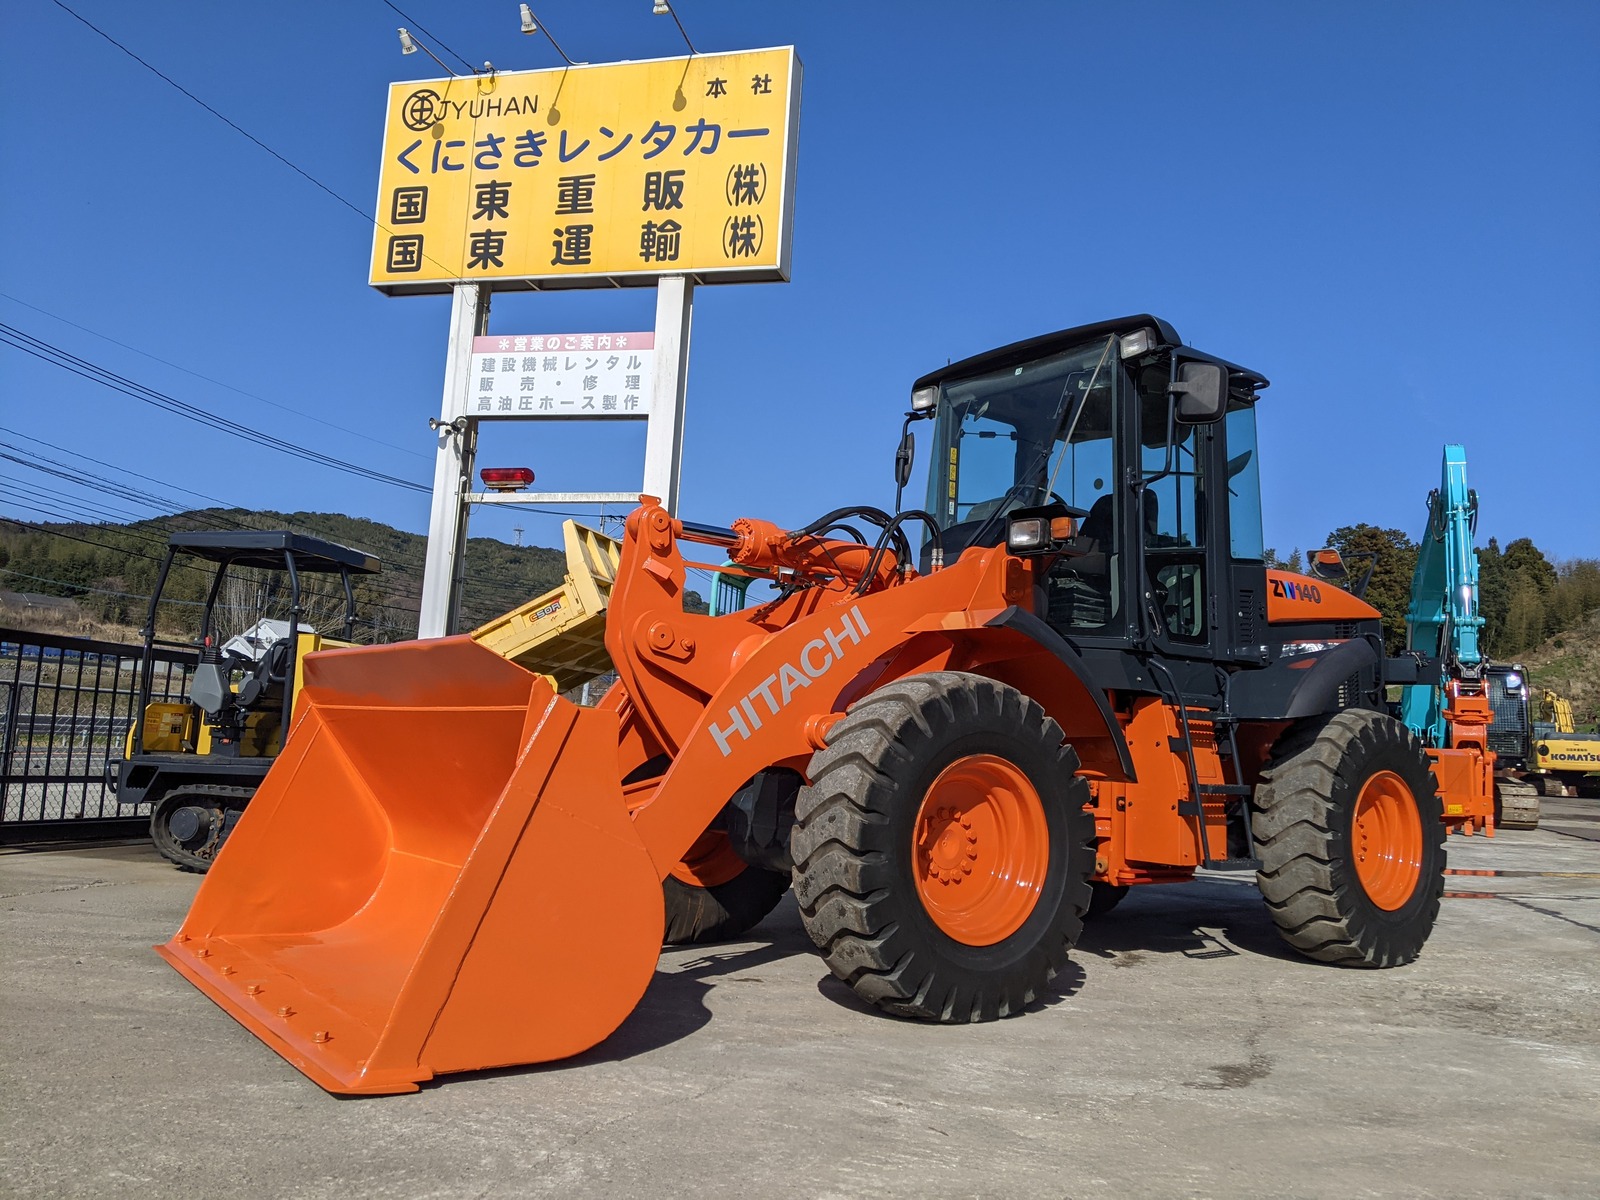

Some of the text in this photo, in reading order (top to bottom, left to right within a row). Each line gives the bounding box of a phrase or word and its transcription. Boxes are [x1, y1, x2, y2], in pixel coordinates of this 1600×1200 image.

[705, 73, 773, 99] 本社
[434, 95, 538, 120] JYUHAN
[397, 118, 769, 174] くにさきレンタカー
[481, 355, 642, 373] 建設機械レンタル
[477, 395, 640, 412] 高油圧ホース製作
[708, 605, 871, 757] HITACHI
